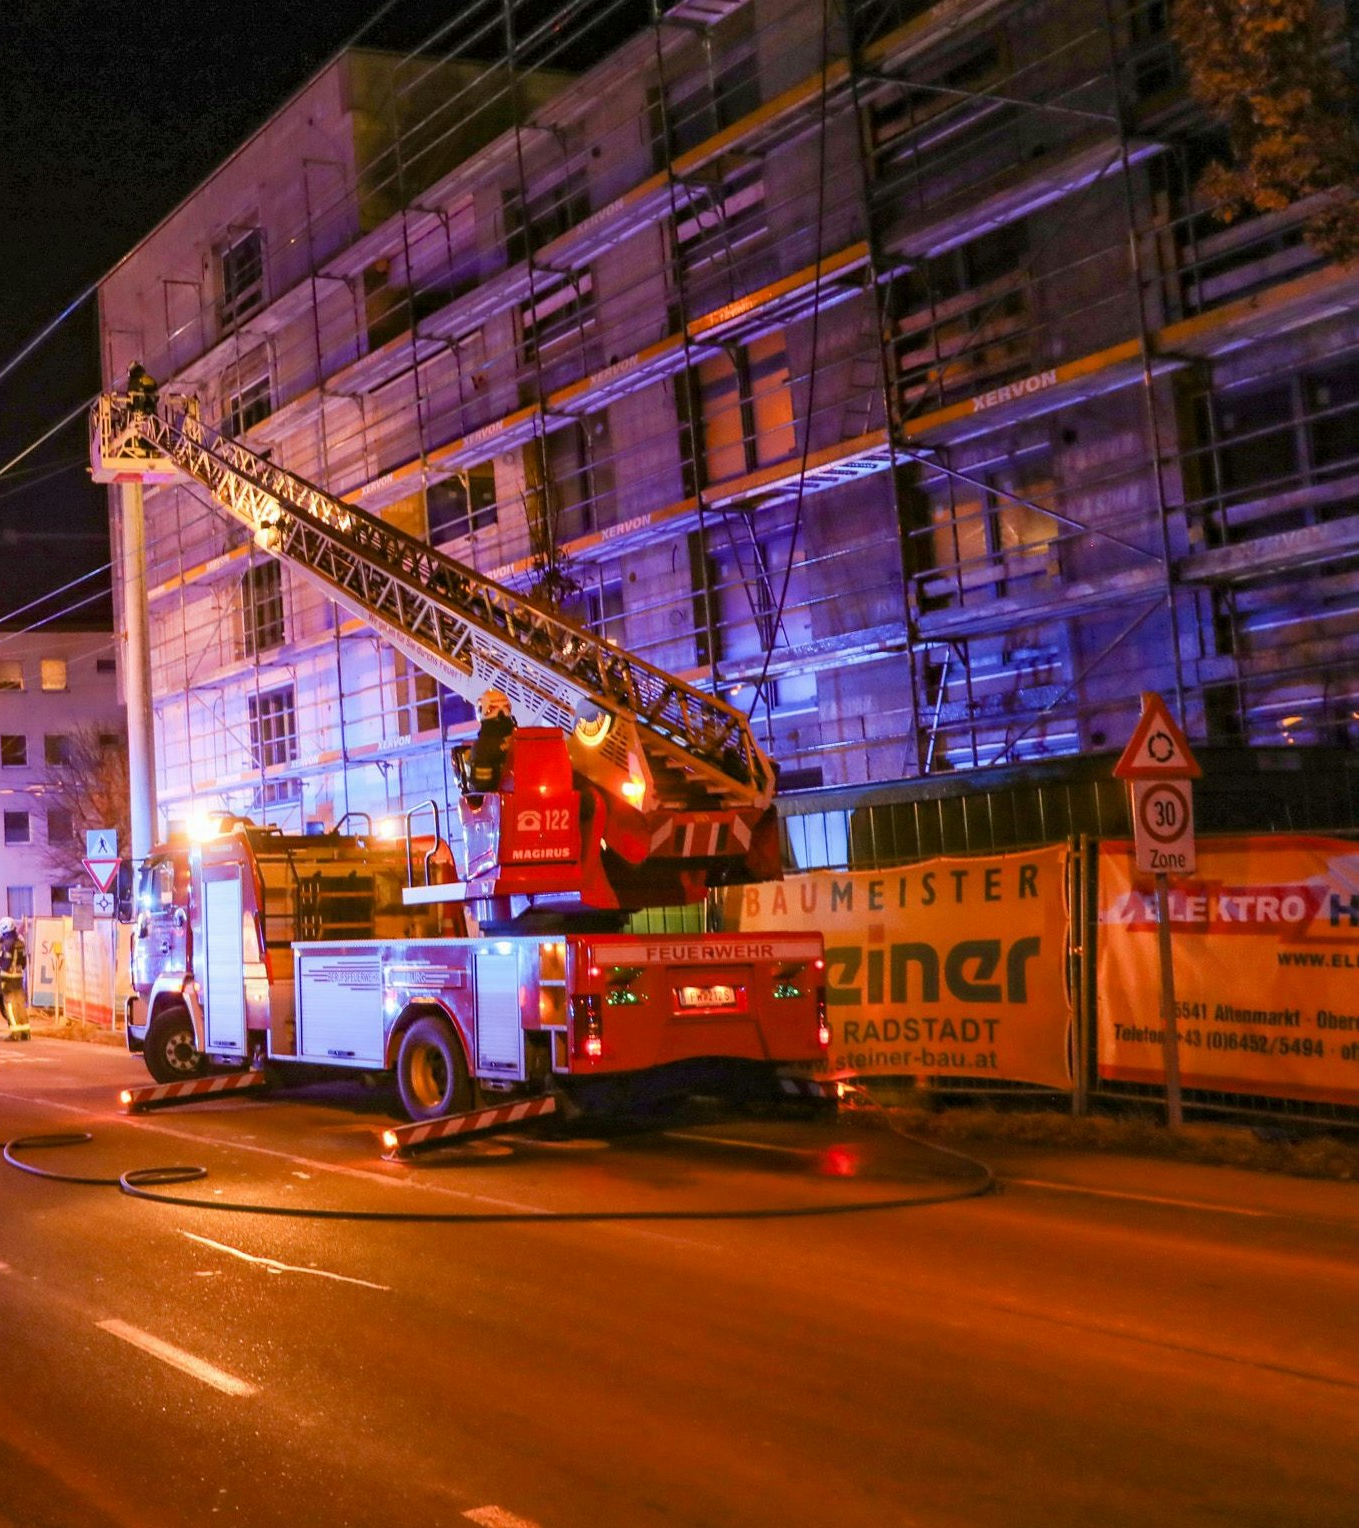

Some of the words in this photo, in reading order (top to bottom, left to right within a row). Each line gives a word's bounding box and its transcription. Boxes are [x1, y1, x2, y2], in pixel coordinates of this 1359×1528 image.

[972, 368, 1057, 412] XERVON
[463, 421, 504, 449] XERVON
[600, 514, 652, 541] XERVON
[377, 734, 411, 752] XERVON
[545, 808, 570, 830] 122
[1154, 800, 1176, 828] 30
[512, 847, 570, 860] MAGIRUS
[1150, 849, 1186, 869] Zone
[744, 864, 1040, 917] BAUMEISTER
[646, 944, 774, 961] FEUERWEHR
[1277, 952, 1359, 968] WWW.EL
[1214, 1004, 1300, 1027] Altenmarkt
[844, 1017, 1000, 1044] RADSTADT
[1206, 1032, 1324, 1058] (0)6452/5494
